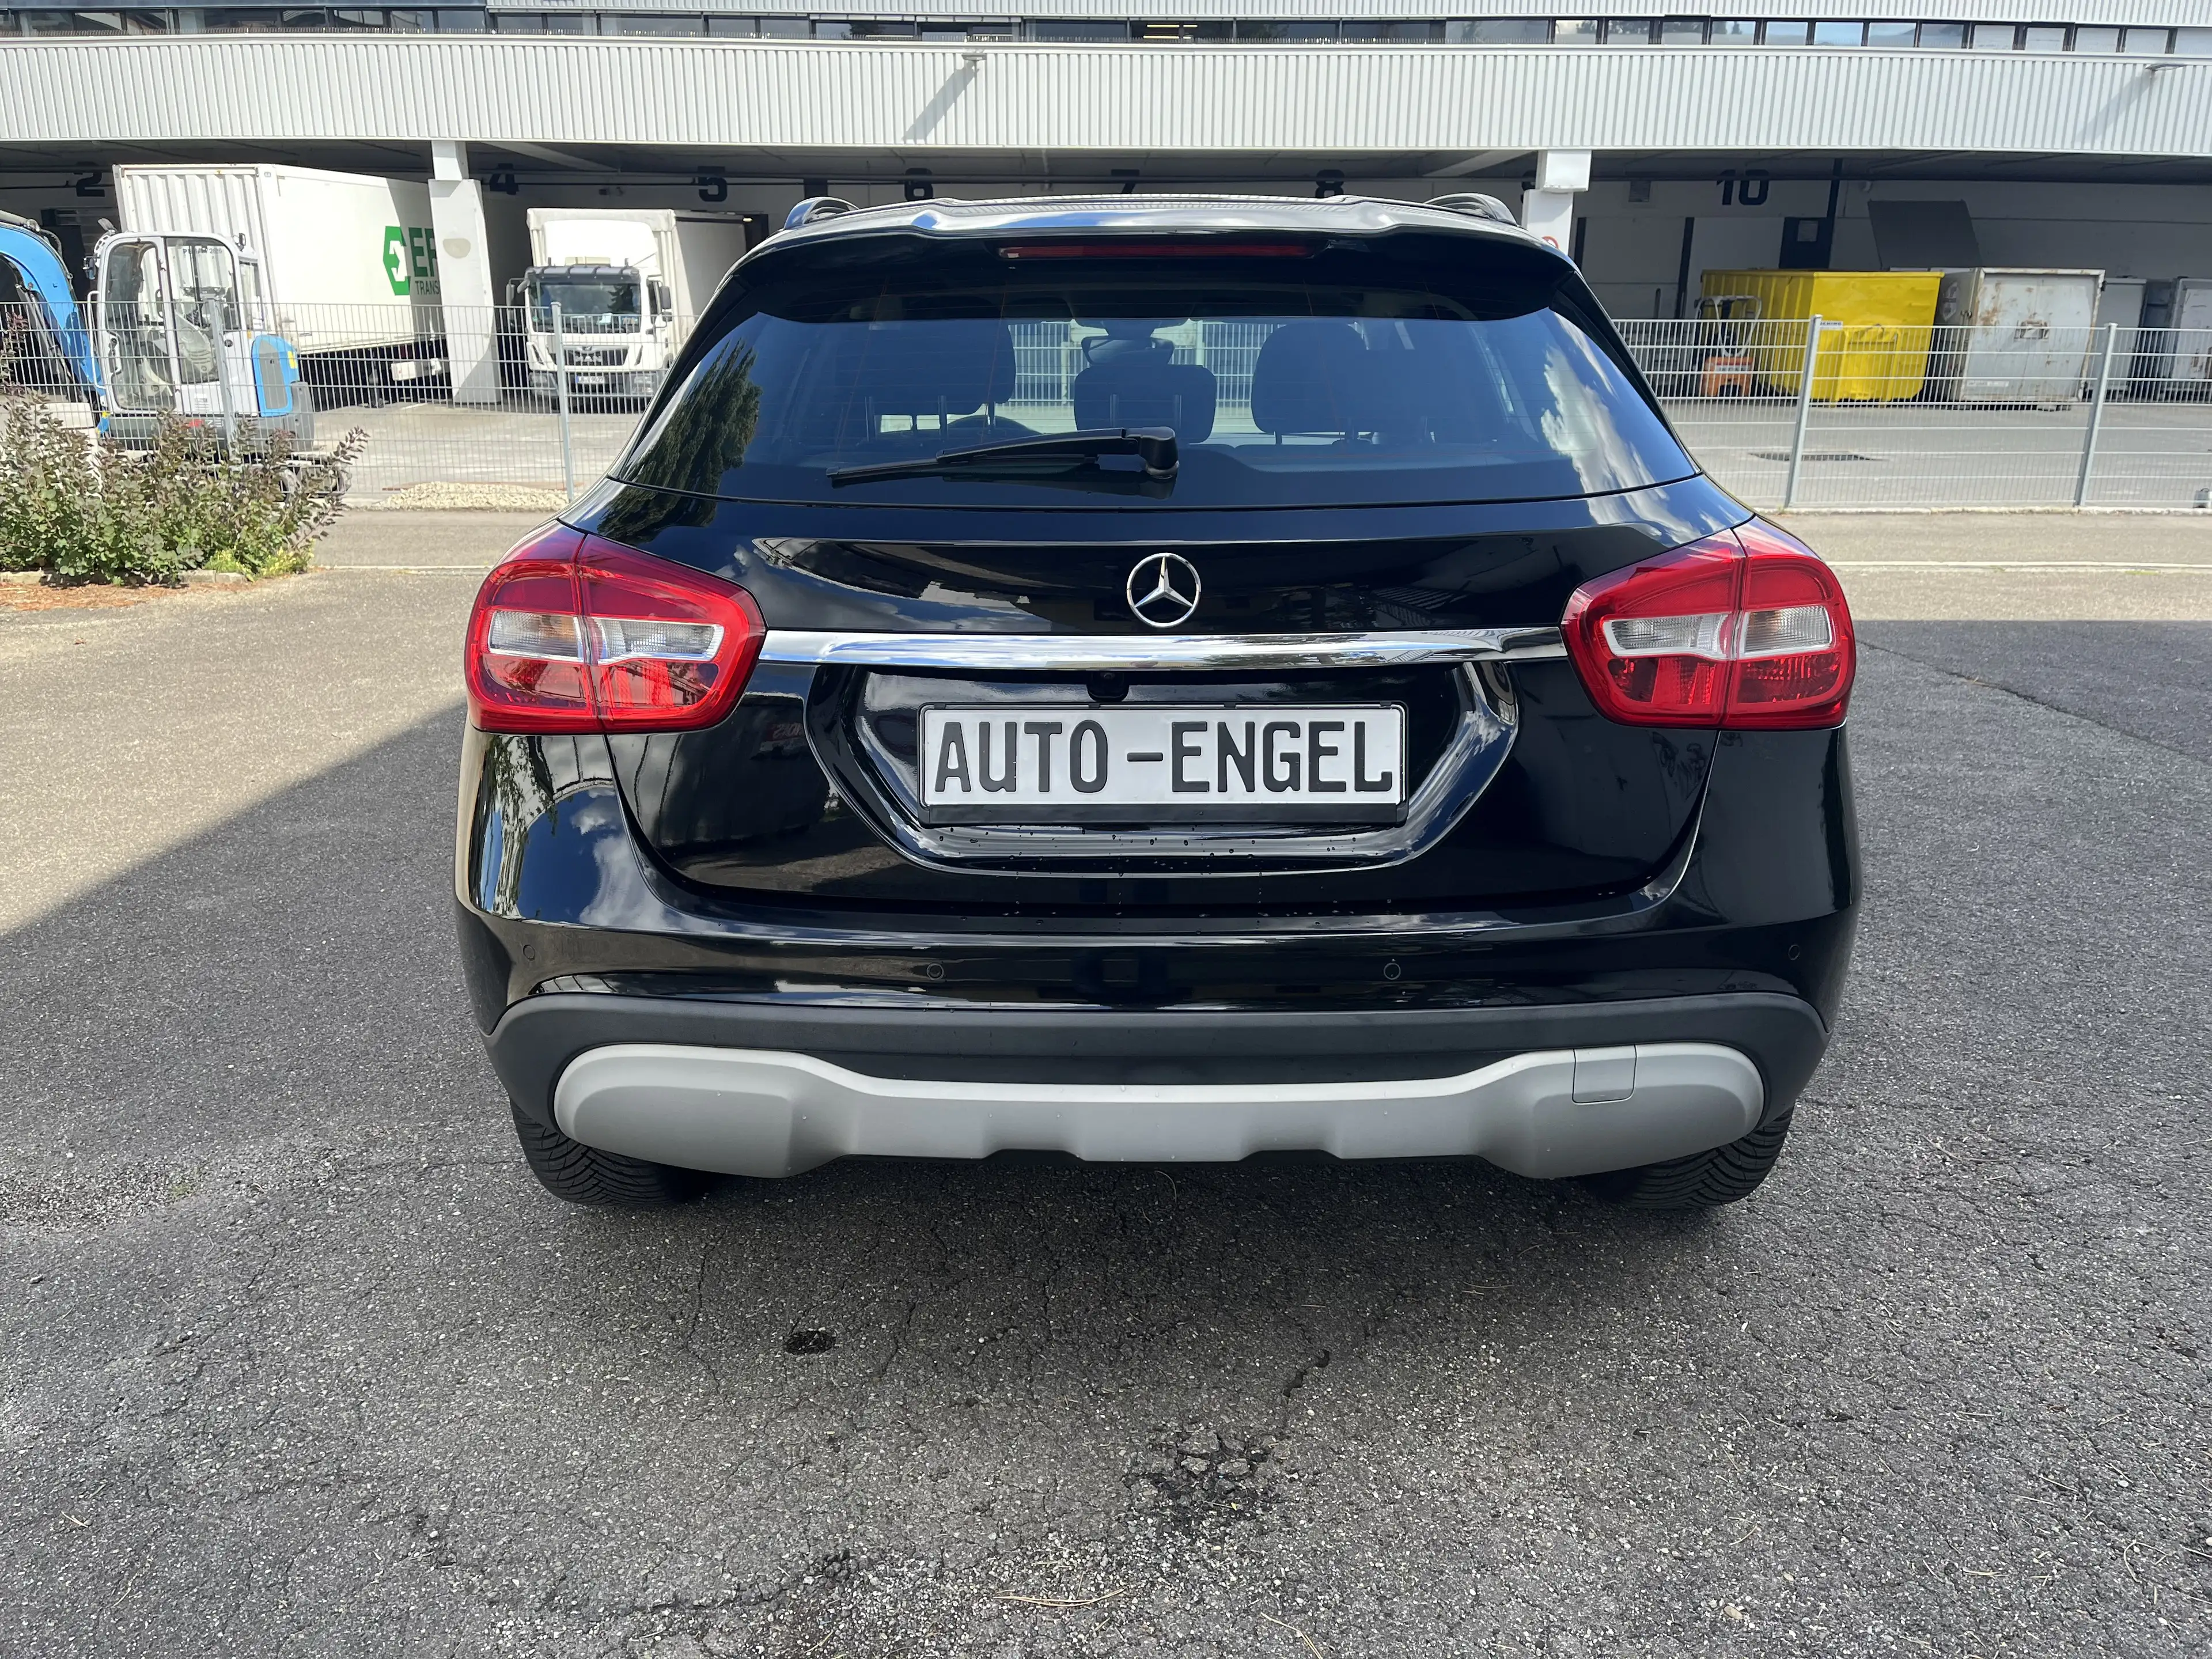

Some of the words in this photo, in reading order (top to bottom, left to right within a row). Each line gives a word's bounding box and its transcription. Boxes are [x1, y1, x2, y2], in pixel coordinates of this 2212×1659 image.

[74, 161, 105, 197] 2
[489, 163, 519, 195] 4
[698, 166, 728, 202] 5
[904, 168, 933, 201] 6
[1111, 169, 1140, 194] 7
[1315, 169, 1345, 198] 8
[1717, 169, 1770, 205] 10
